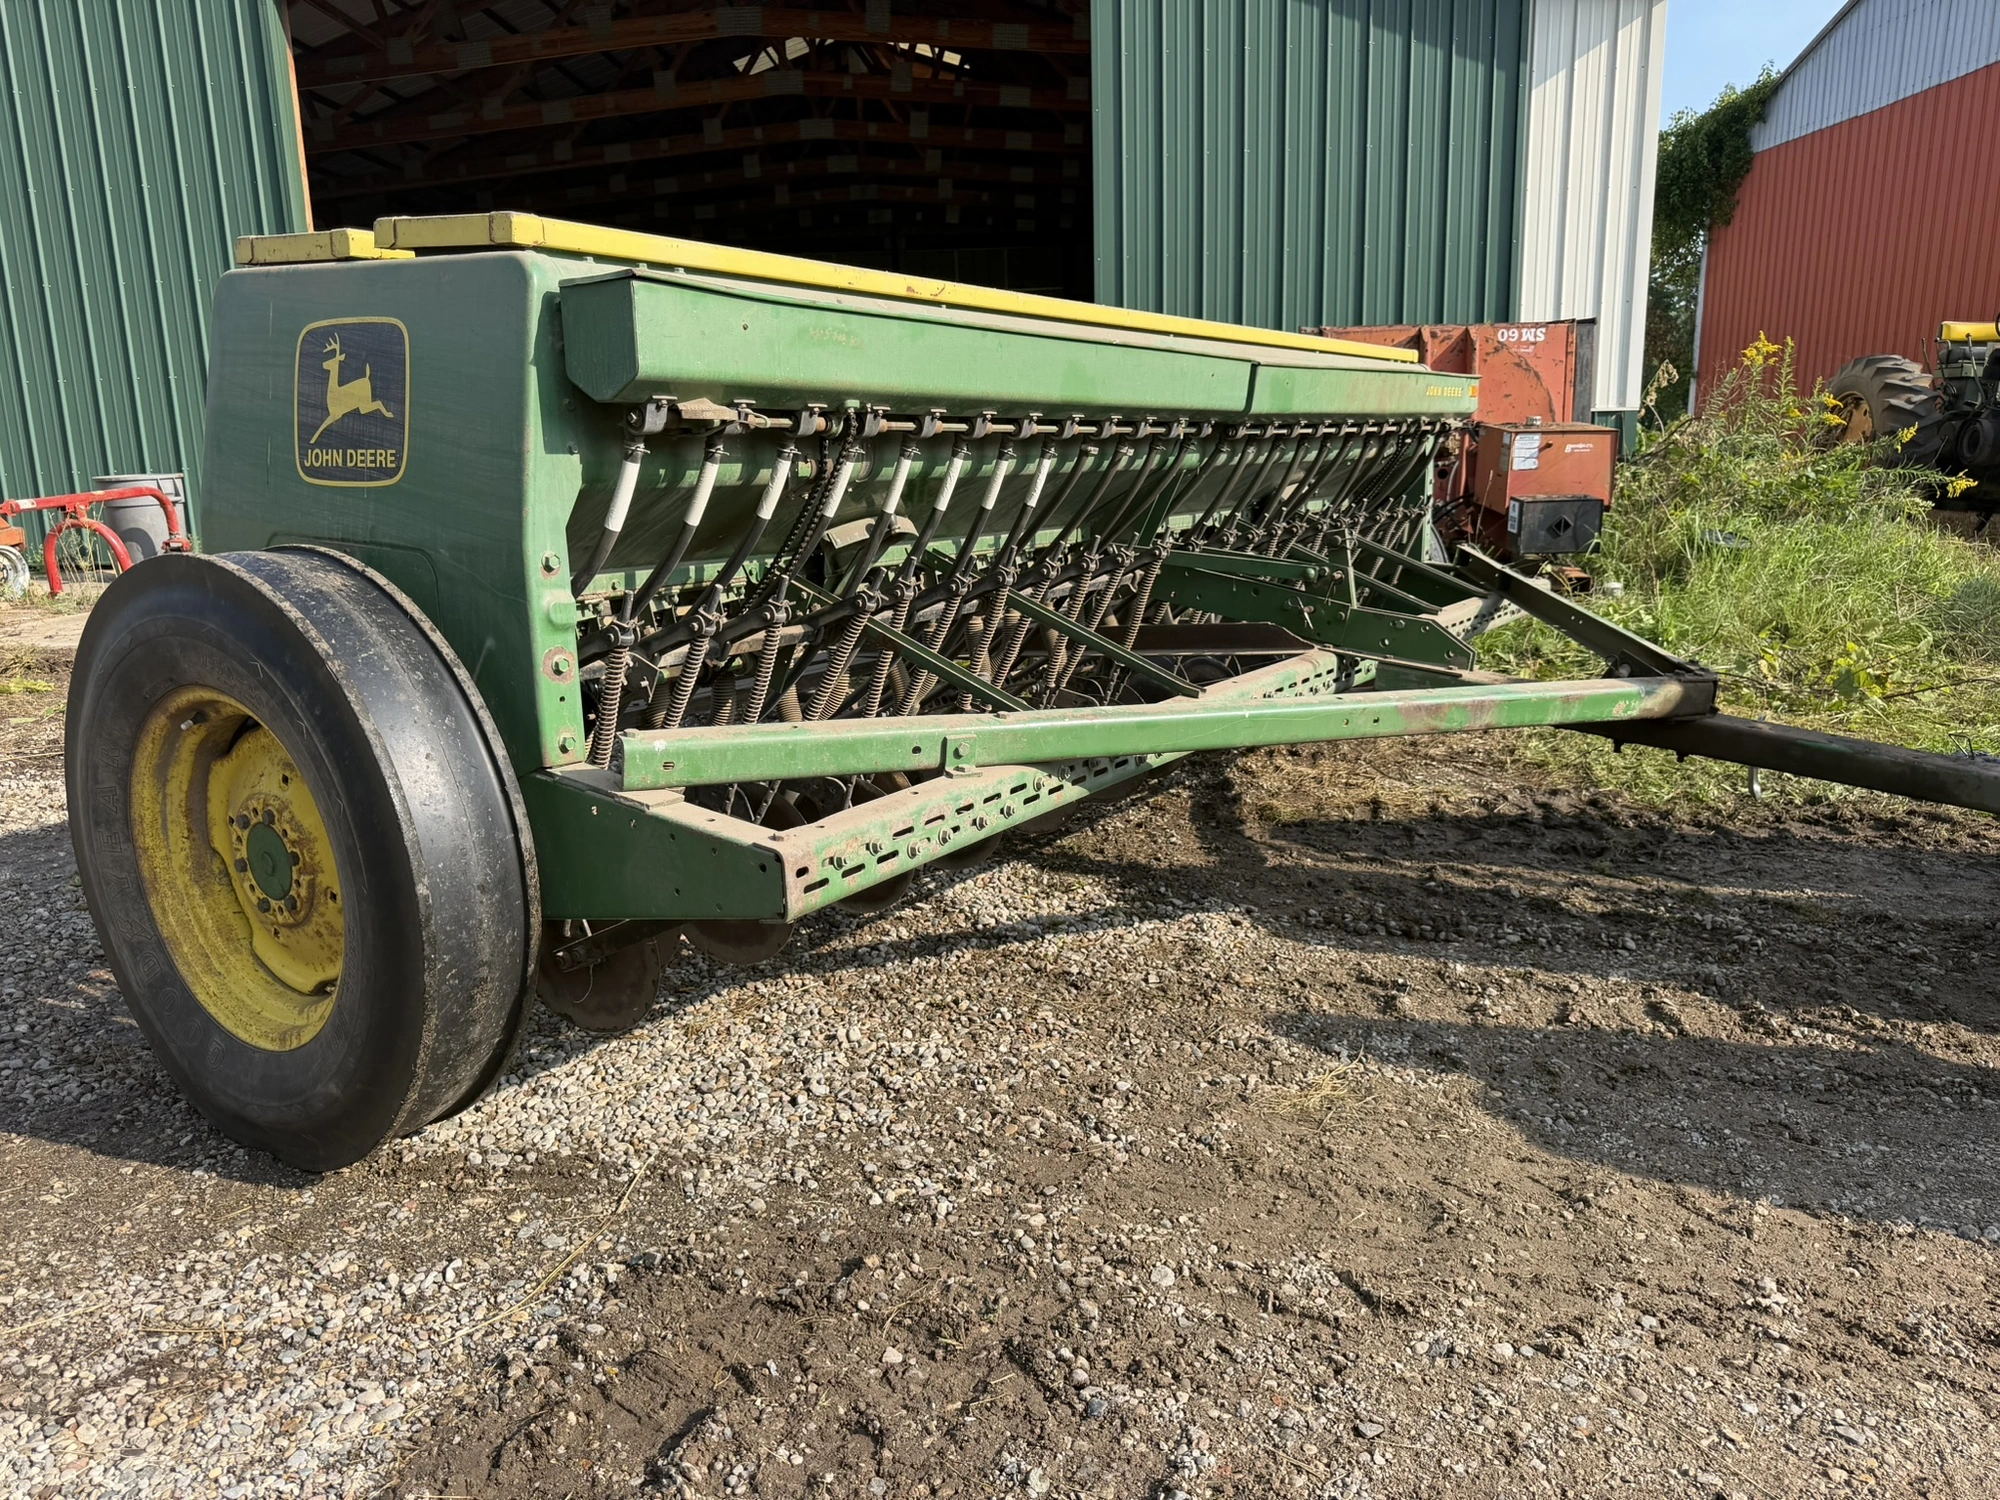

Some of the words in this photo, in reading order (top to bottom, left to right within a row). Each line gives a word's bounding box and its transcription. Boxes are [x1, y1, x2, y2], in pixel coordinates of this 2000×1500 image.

[1497, 328, 1519, 342] 60
[1521, 327, 1547, 342] SM
[1426, 385, 1442, 396] JOHN
[1443, 386, 1463, 397] DEERE
[304, 448, 343, 468] JOHN
[346, 449, 396, 468] DEERE
